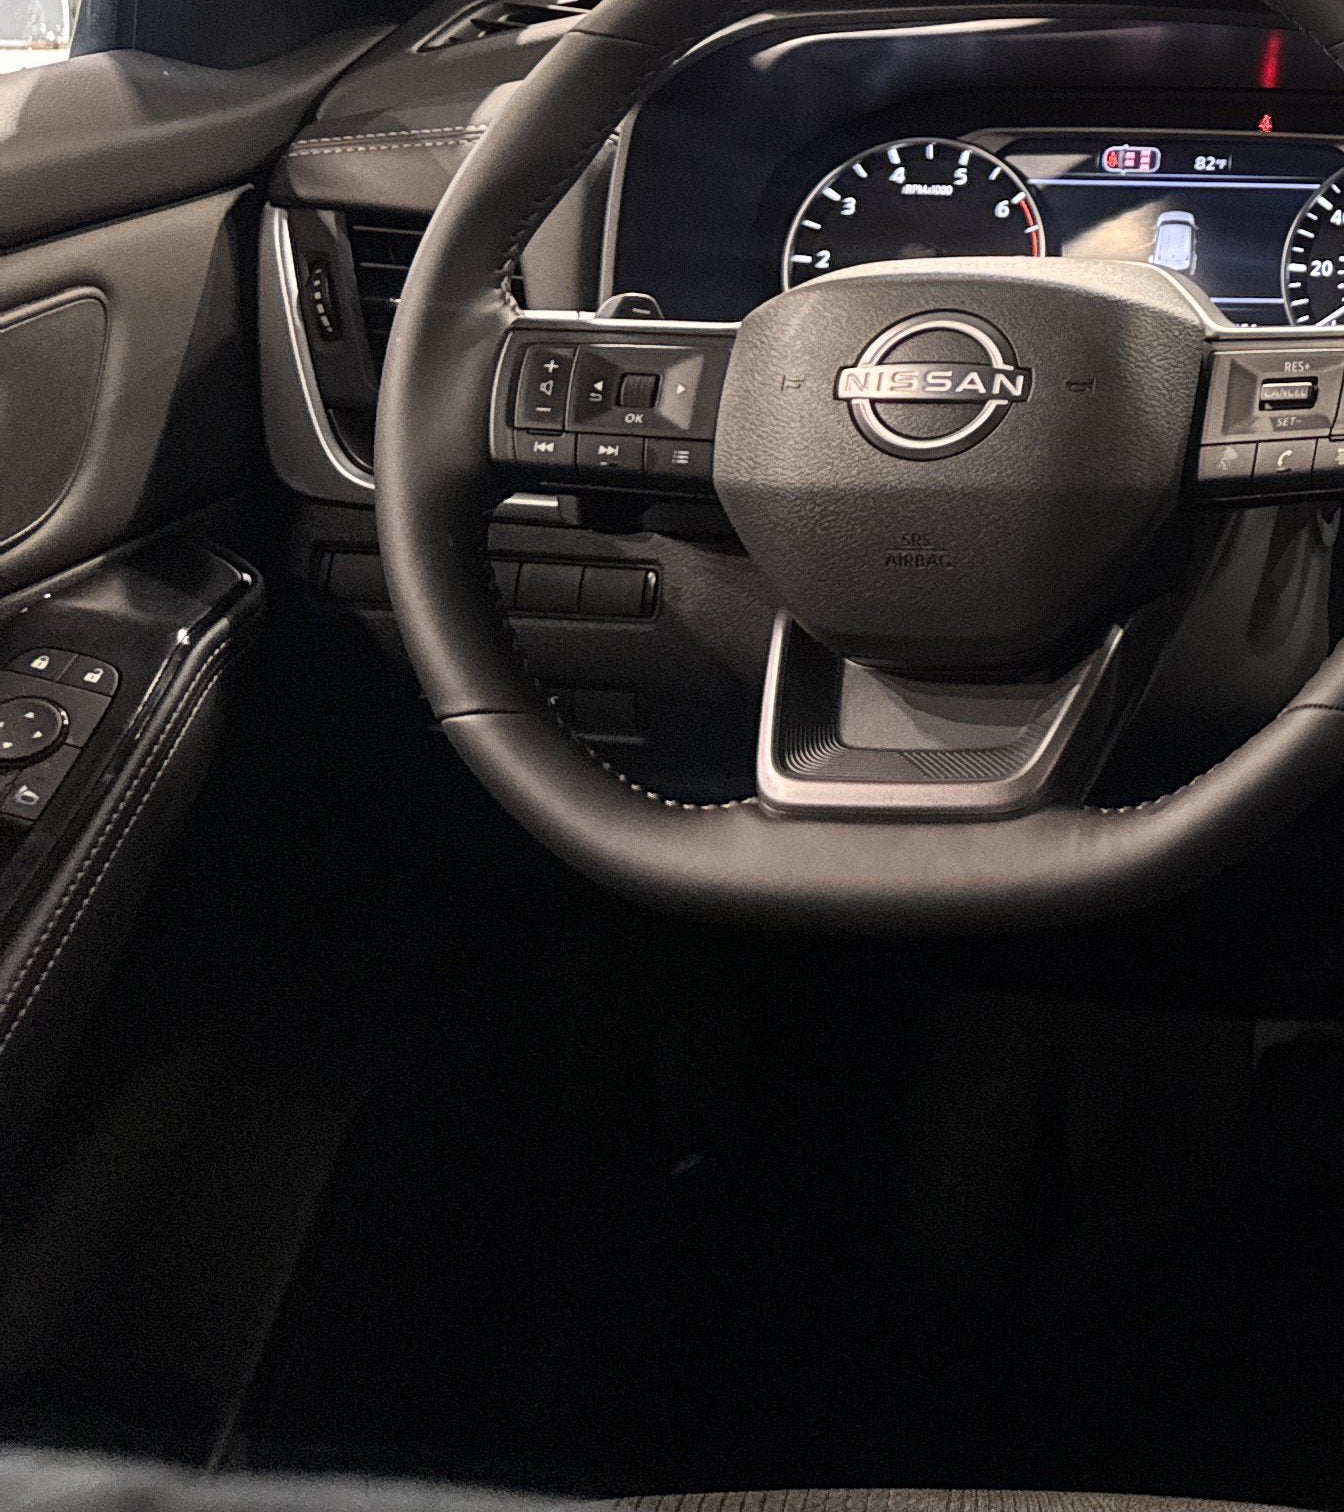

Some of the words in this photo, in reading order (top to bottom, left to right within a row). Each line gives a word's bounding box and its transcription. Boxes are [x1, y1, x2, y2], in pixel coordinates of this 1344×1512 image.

[888, 166, 907, 184] 4
[953, 167, 969, 186] 5
[840, 196, 857, 216] 3
[994, 199, 1010, 219] 6
[814, 249, 832, 269] 2
[1309, 259, 1334, 278] 20
[1284, 360, 1311, 373] RES+
[844, 369, 1025, 397] NISSAN
[1264, 386, 1307, 398] CANCEL
[624, 412, 644, 425] OK
[901, 533, 931, 547] SRS
